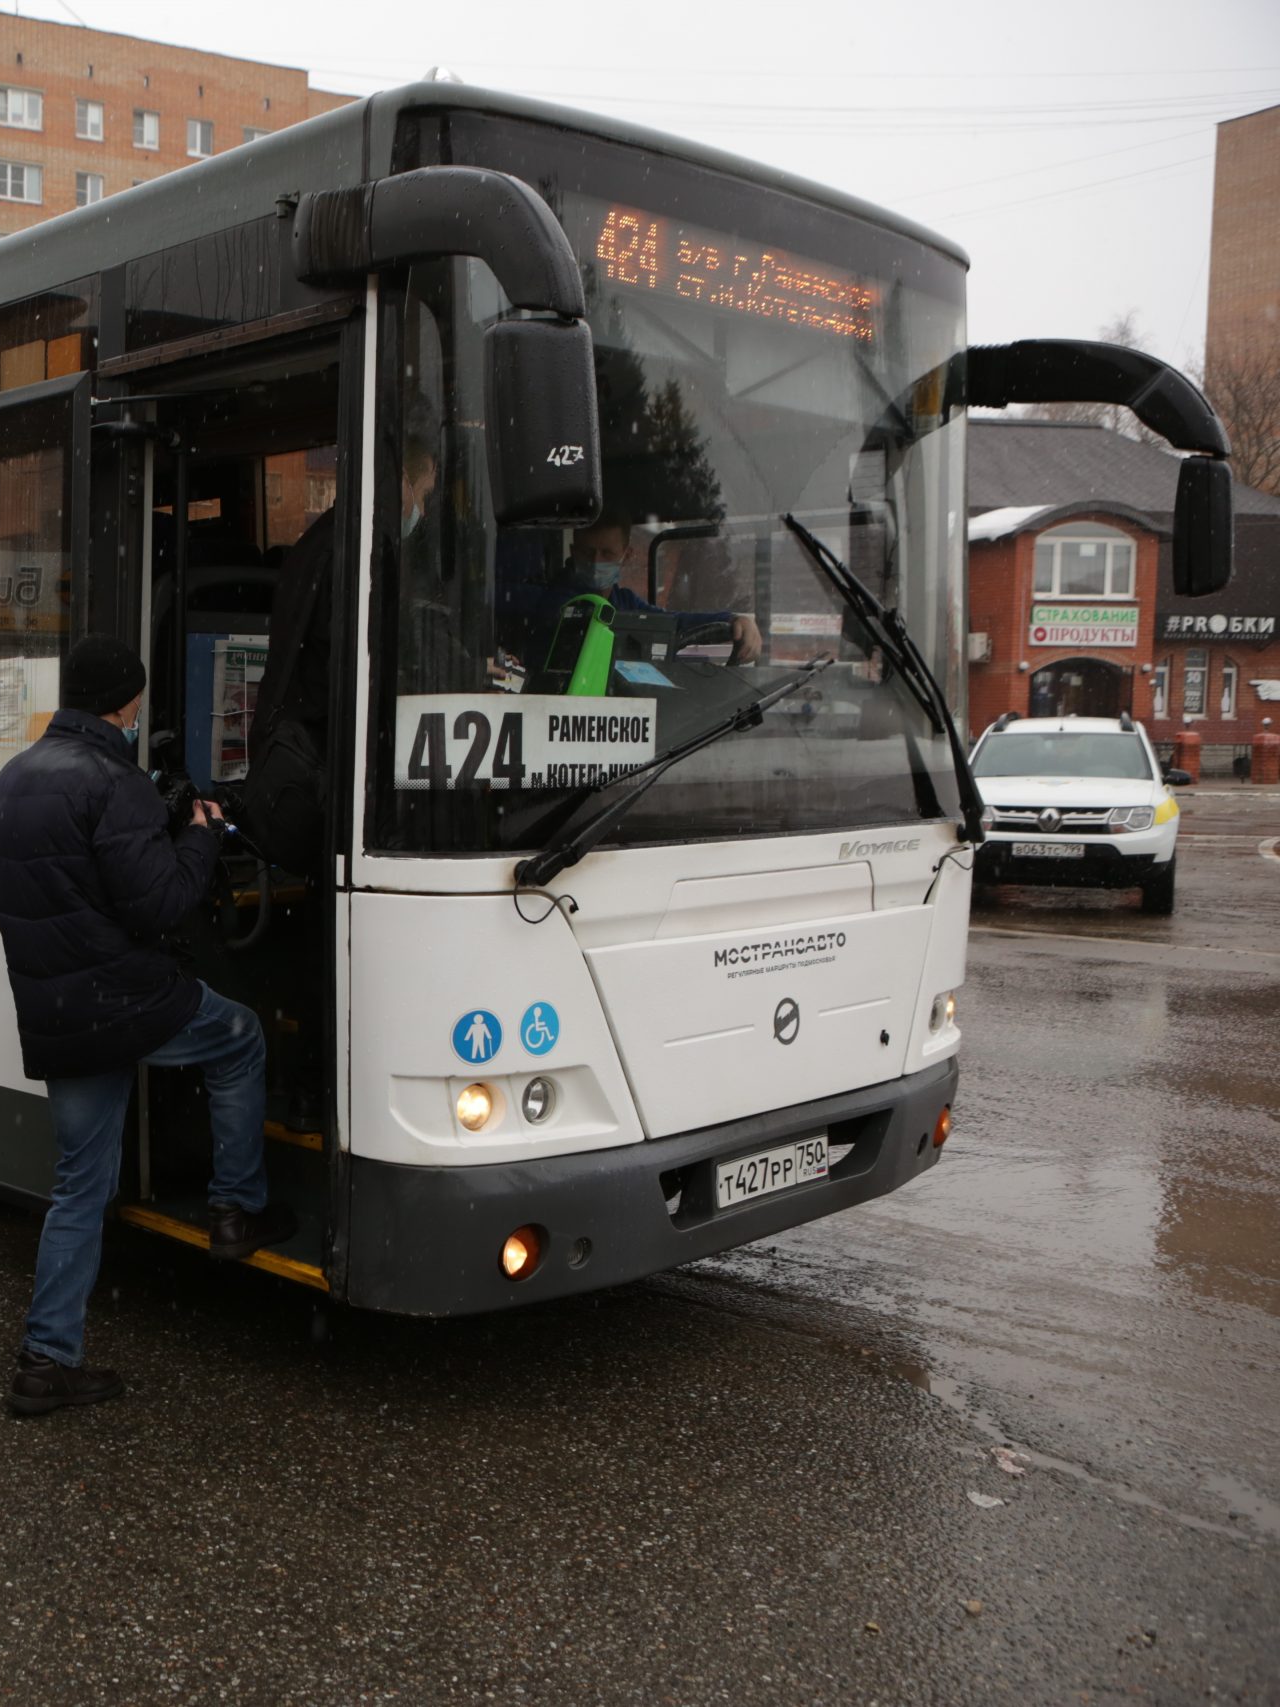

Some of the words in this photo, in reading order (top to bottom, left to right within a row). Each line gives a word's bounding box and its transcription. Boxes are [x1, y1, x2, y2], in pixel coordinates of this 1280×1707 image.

[596, 211, 658, 288] 424
[547, 445, 584, 467] 427
[1036, 608, 1137, 622] СТРАХОВАНИЕ
[1049, 627, 1136, 643] ПРОДУКТЫ
[408, 710, 526, 788] 424
[548, 714, 650, 743] РАМЕНСКОЕ
[714, 932, 846, 967] МОСТРАНСАВТО
[727, 967, 765, 979] РЕГУЛЯРНЫЕ
[765, 962, 797, 974] МАРШРУТЫ
[797, 955, 836, 968] ПОДМОСКОВЬЯ
[724, 1157, 793, 1200] Т427РР
[797, 1141, 822, 1170] 750
[803, 1167, 816, 1177] RUS
